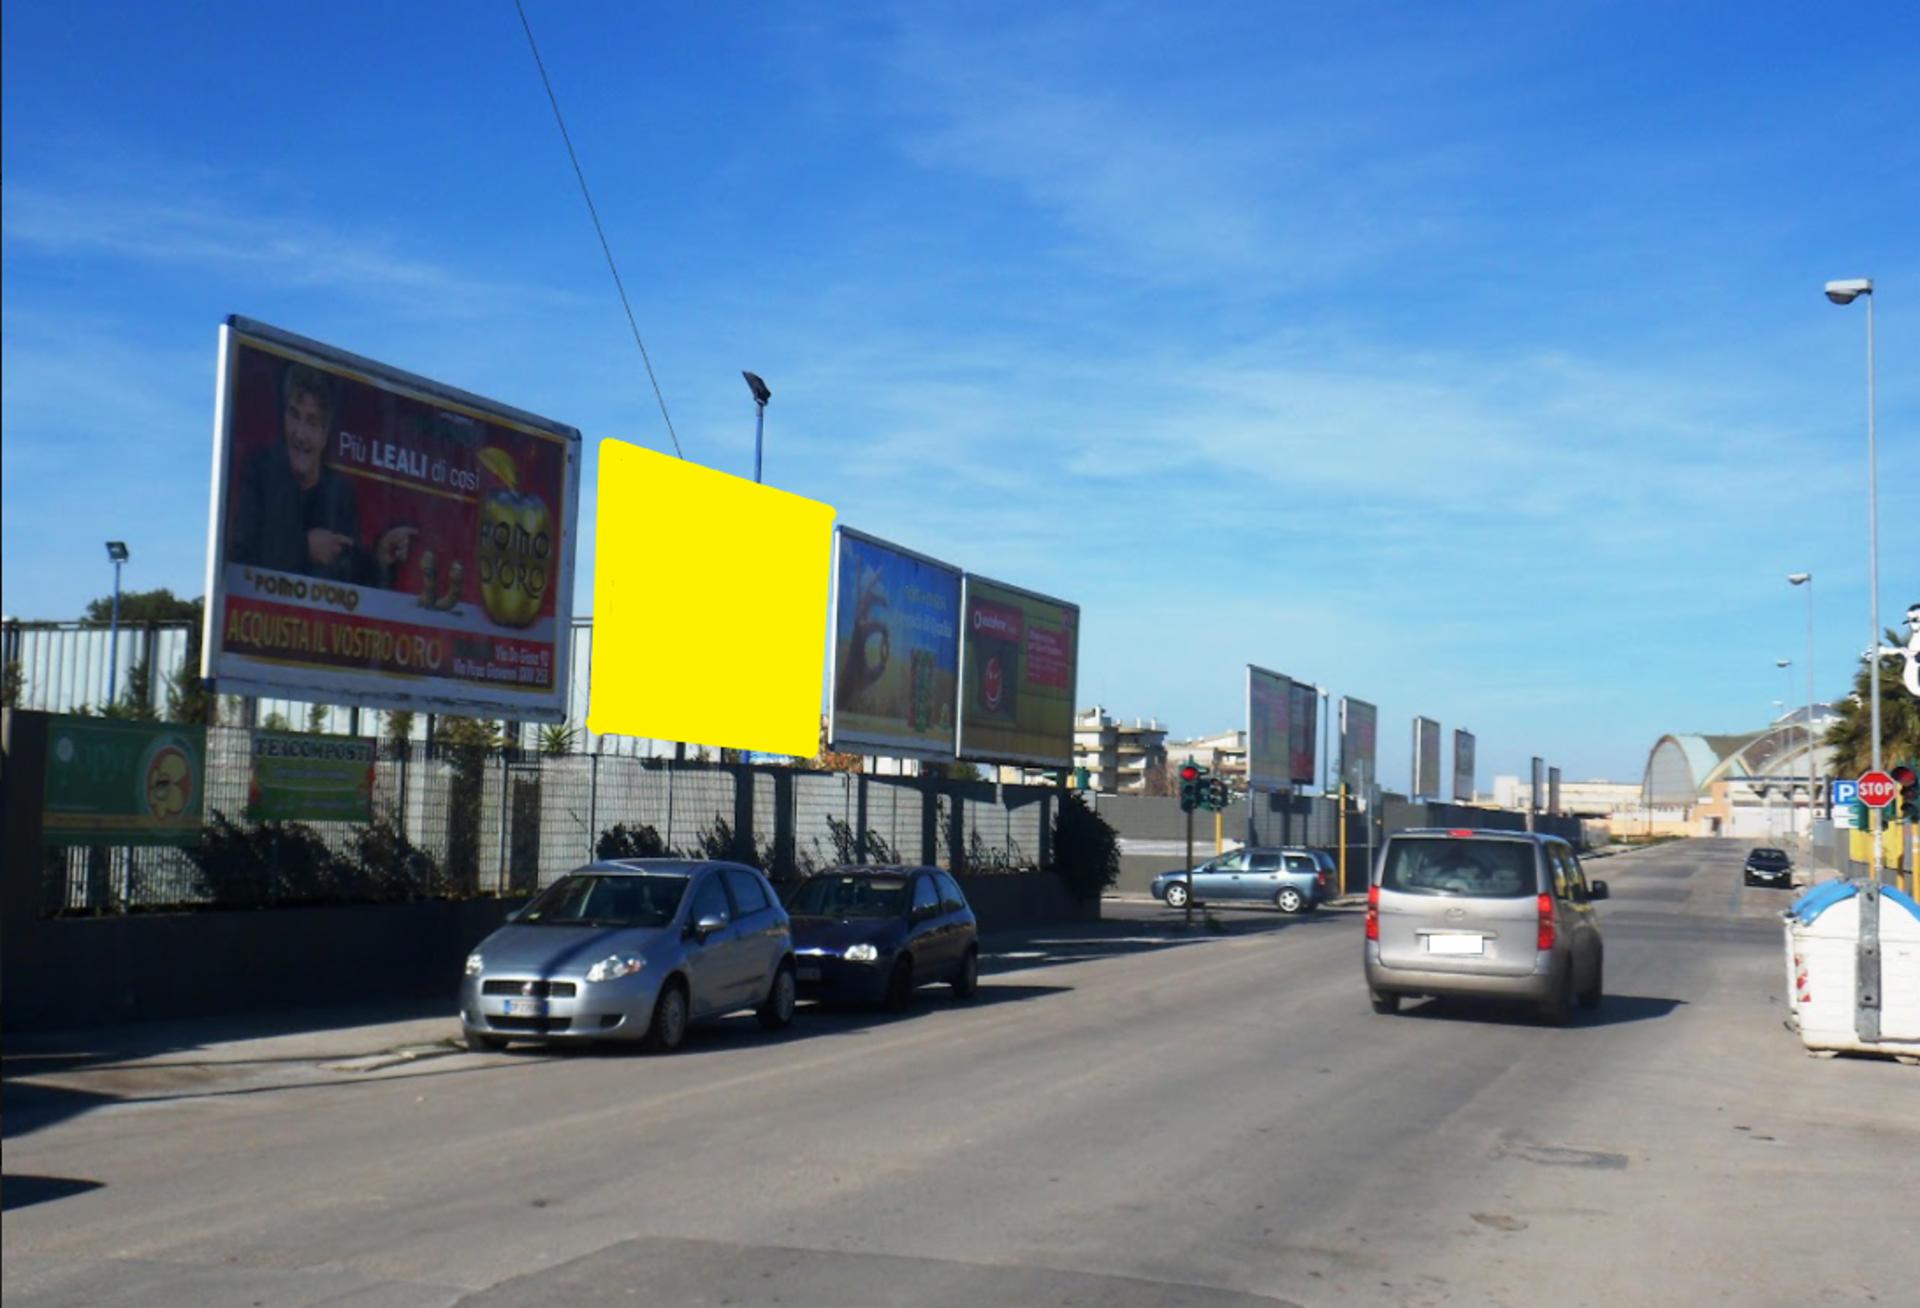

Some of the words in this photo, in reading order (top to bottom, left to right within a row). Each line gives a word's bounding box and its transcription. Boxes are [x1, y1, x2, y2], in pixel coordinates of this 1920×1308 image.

[339, 432, 366, 463] Più
[371, 440, 428, 479] LEALI
[431, 457, 446, 484] di
[480, 521, 550, 557] POMO
[255, 574, 307, 599] POMO
[228, 608, 309, 648] ACQUISTA
[313, 620, 327, 653] IL
[331, 623, 393, 662] VOSTRO
[395, 633, 443, 670] ORO
[1838, 784, 1854, 802] P
[1859, 782, 1894, 797] STOP
